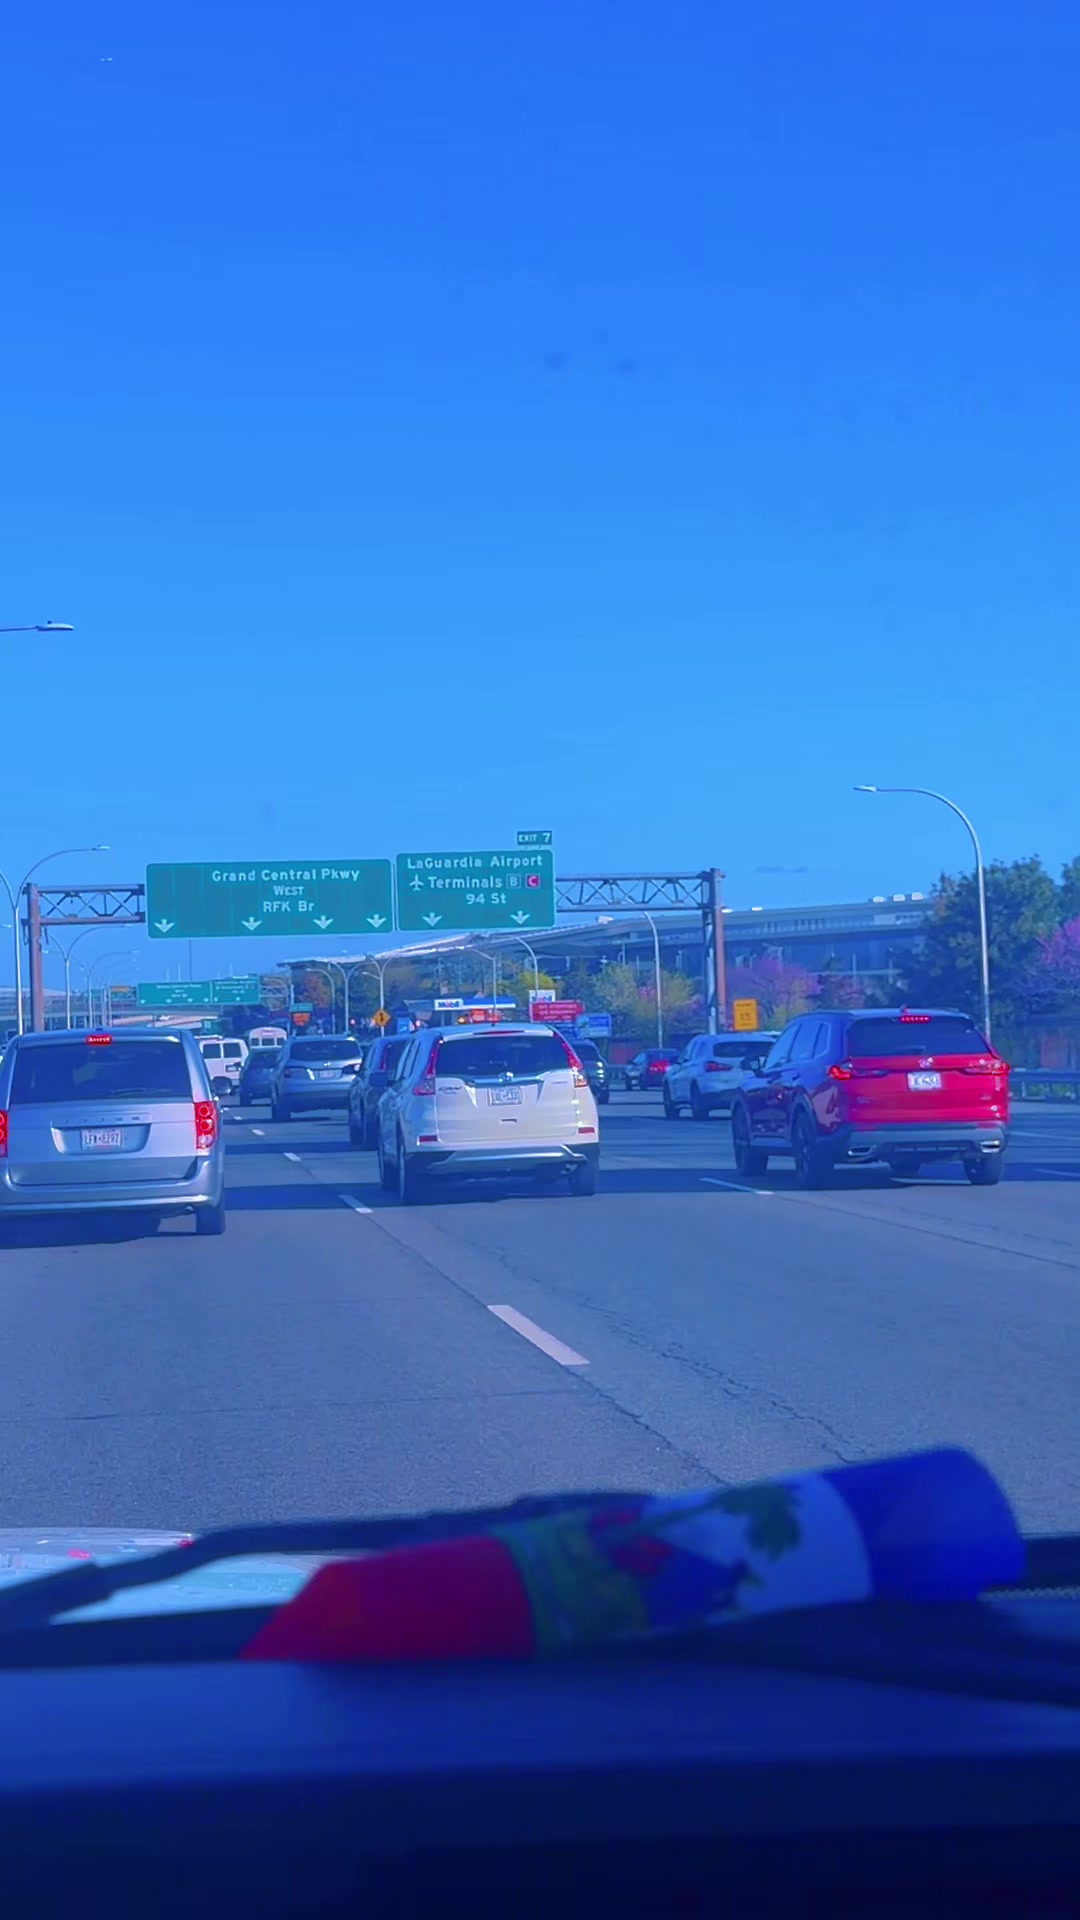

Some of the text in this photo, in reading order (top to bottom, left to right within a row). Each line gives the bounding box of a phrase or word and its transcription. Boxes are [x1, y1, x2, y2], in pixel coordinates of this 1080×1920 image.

[518, 832, 551, 844] EXIT 7
[406, 854, 543, 870] LaGuardia Airport
[211, 867, 361, 882] Grand Central Pkwy
[427, 875, 538, 889] Terminals B C
[465, 892, 507, 905] 94 St
[262, 899, 315, 913] RFK Br
